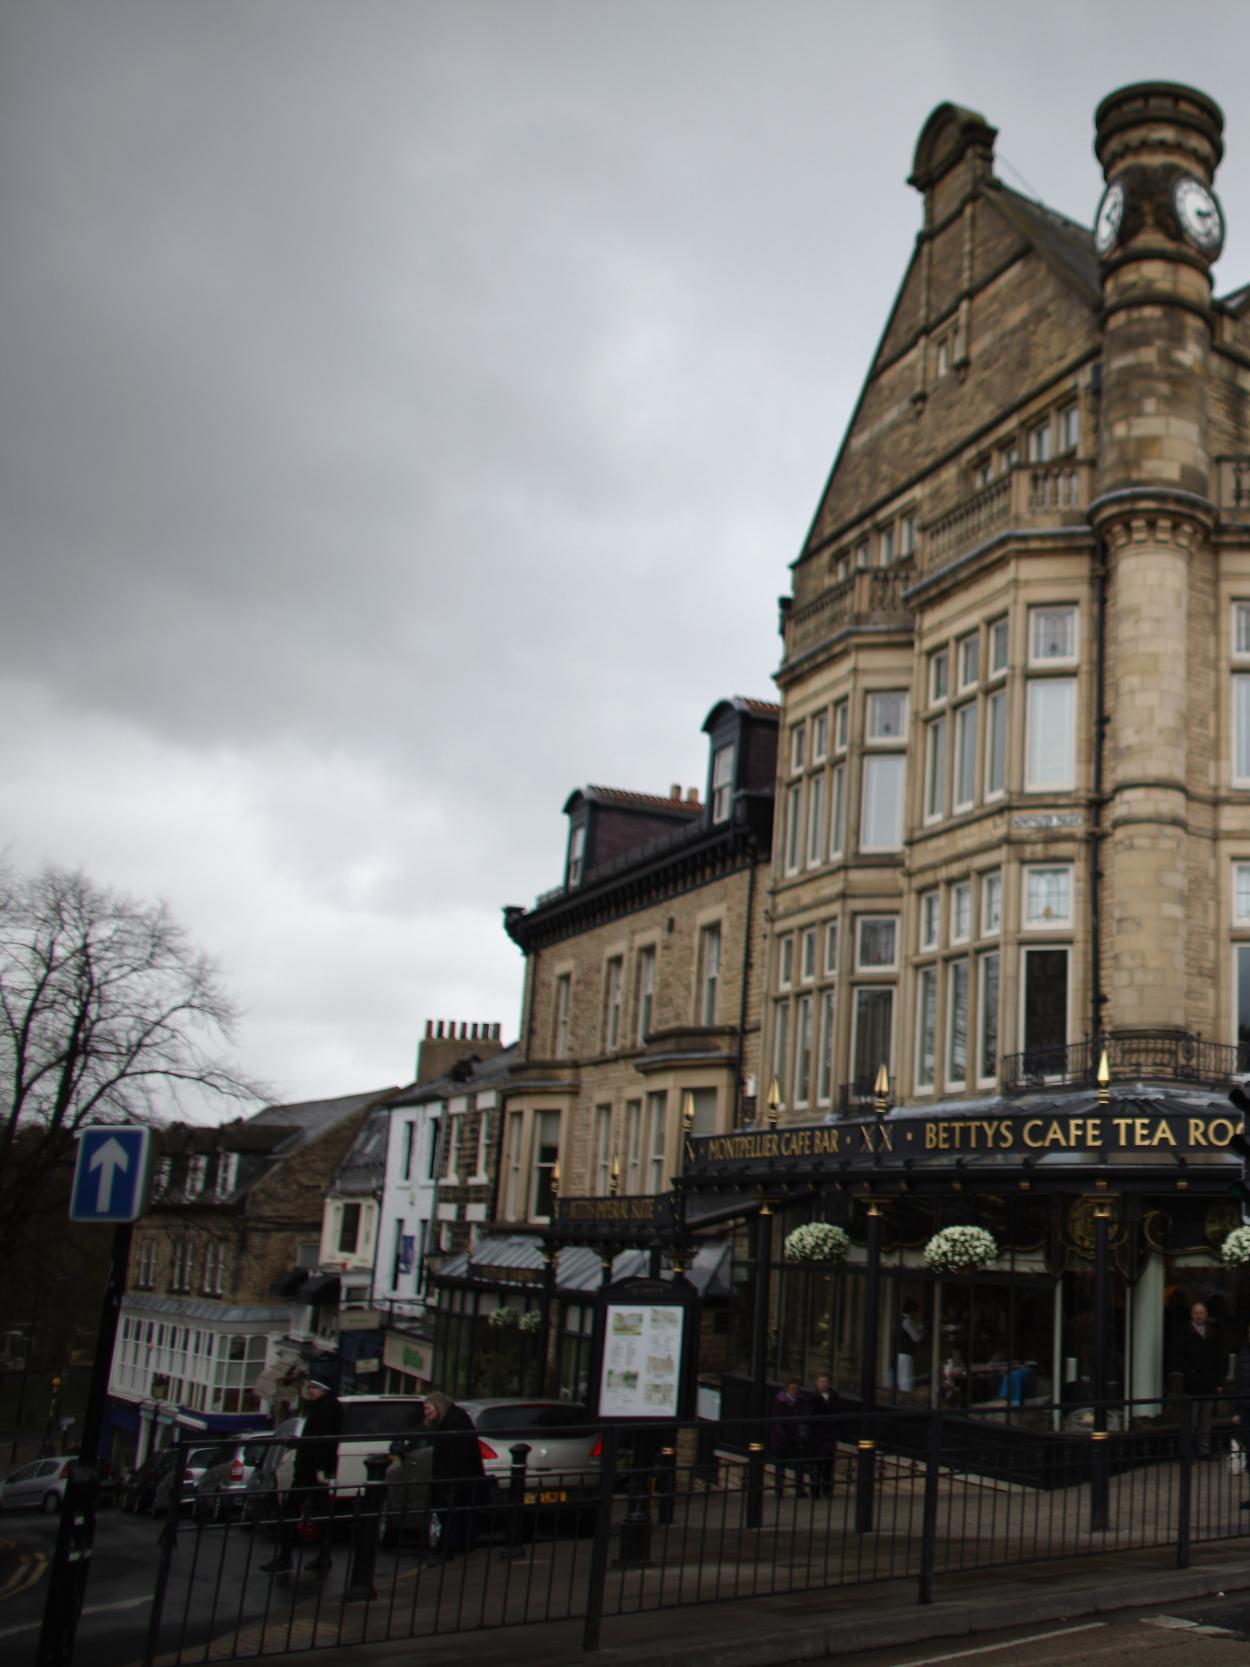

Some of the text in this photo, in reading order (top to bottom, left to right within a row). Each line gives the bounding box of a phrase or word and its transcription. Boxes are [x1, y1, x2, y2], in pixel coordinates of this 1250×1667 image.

[708, 1128, 840, 1160] MONTPELLIER CAFE BAR
[924, 1119, 1014, 1149] BETTYS
[1022, 1118, 1104, 1148] CAFE
[1112, 1117, 1178, 1147] TEA
